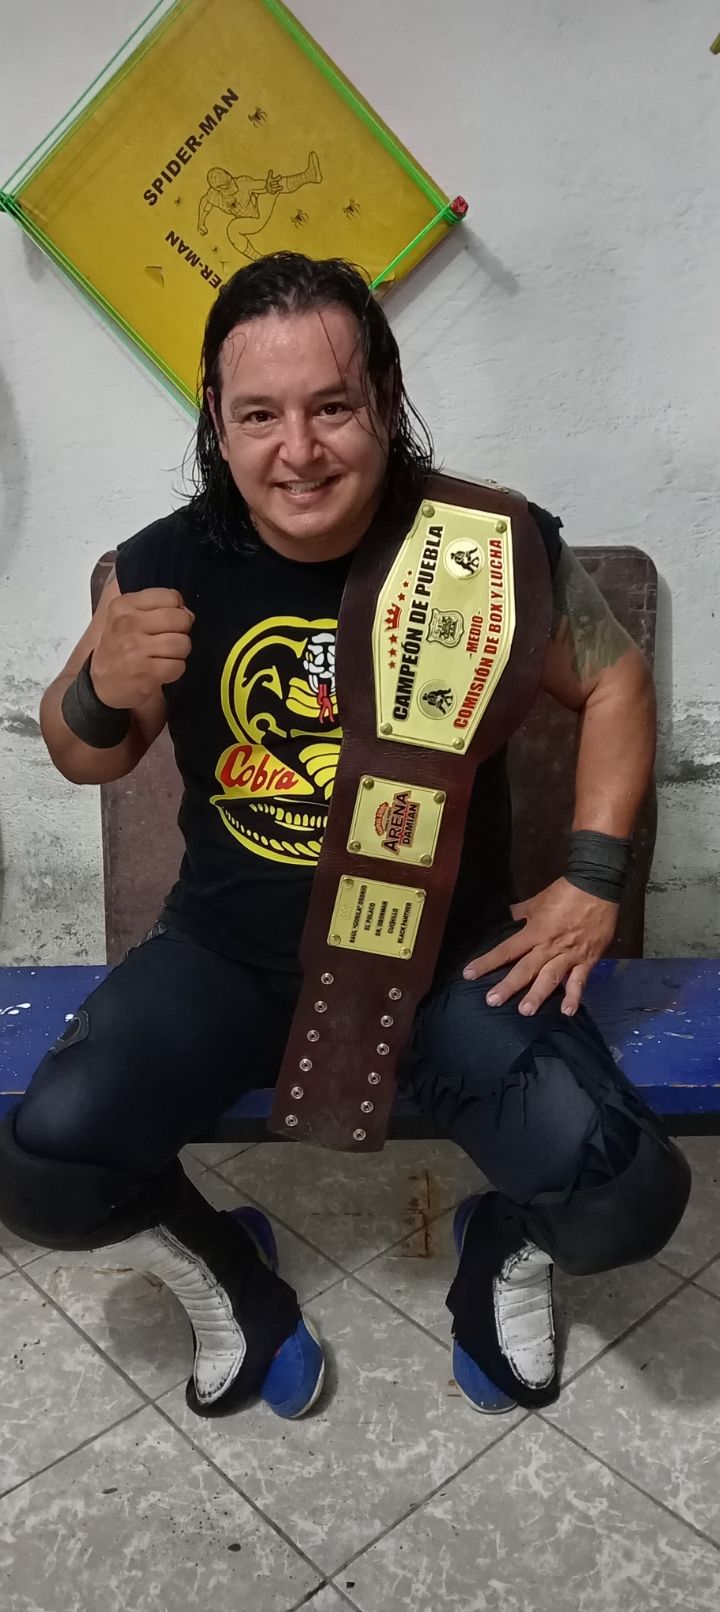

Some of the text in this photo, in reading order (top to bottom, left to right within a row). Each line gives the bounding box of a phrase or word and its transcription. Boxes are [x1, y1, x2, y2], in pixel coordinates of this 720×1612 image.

[143, 87, 240, 206] SPIDER-MAN
[165, 230, 222, 289] ER-MAN
[393, 525, 444, 721] CAMPEÓN DE PUEBLA
[454, 539, 503, 729] COMISIÓN DE BOX Y LUCHA
[219, 744, 299, 793] Cobra
[384, 793, 408, 852] ARENA
[402, 804, 418, 845] DAMIAN
[366, 902, 375, 923] POLACO
[397, 902, 412, 944] BLACK PANTHER
